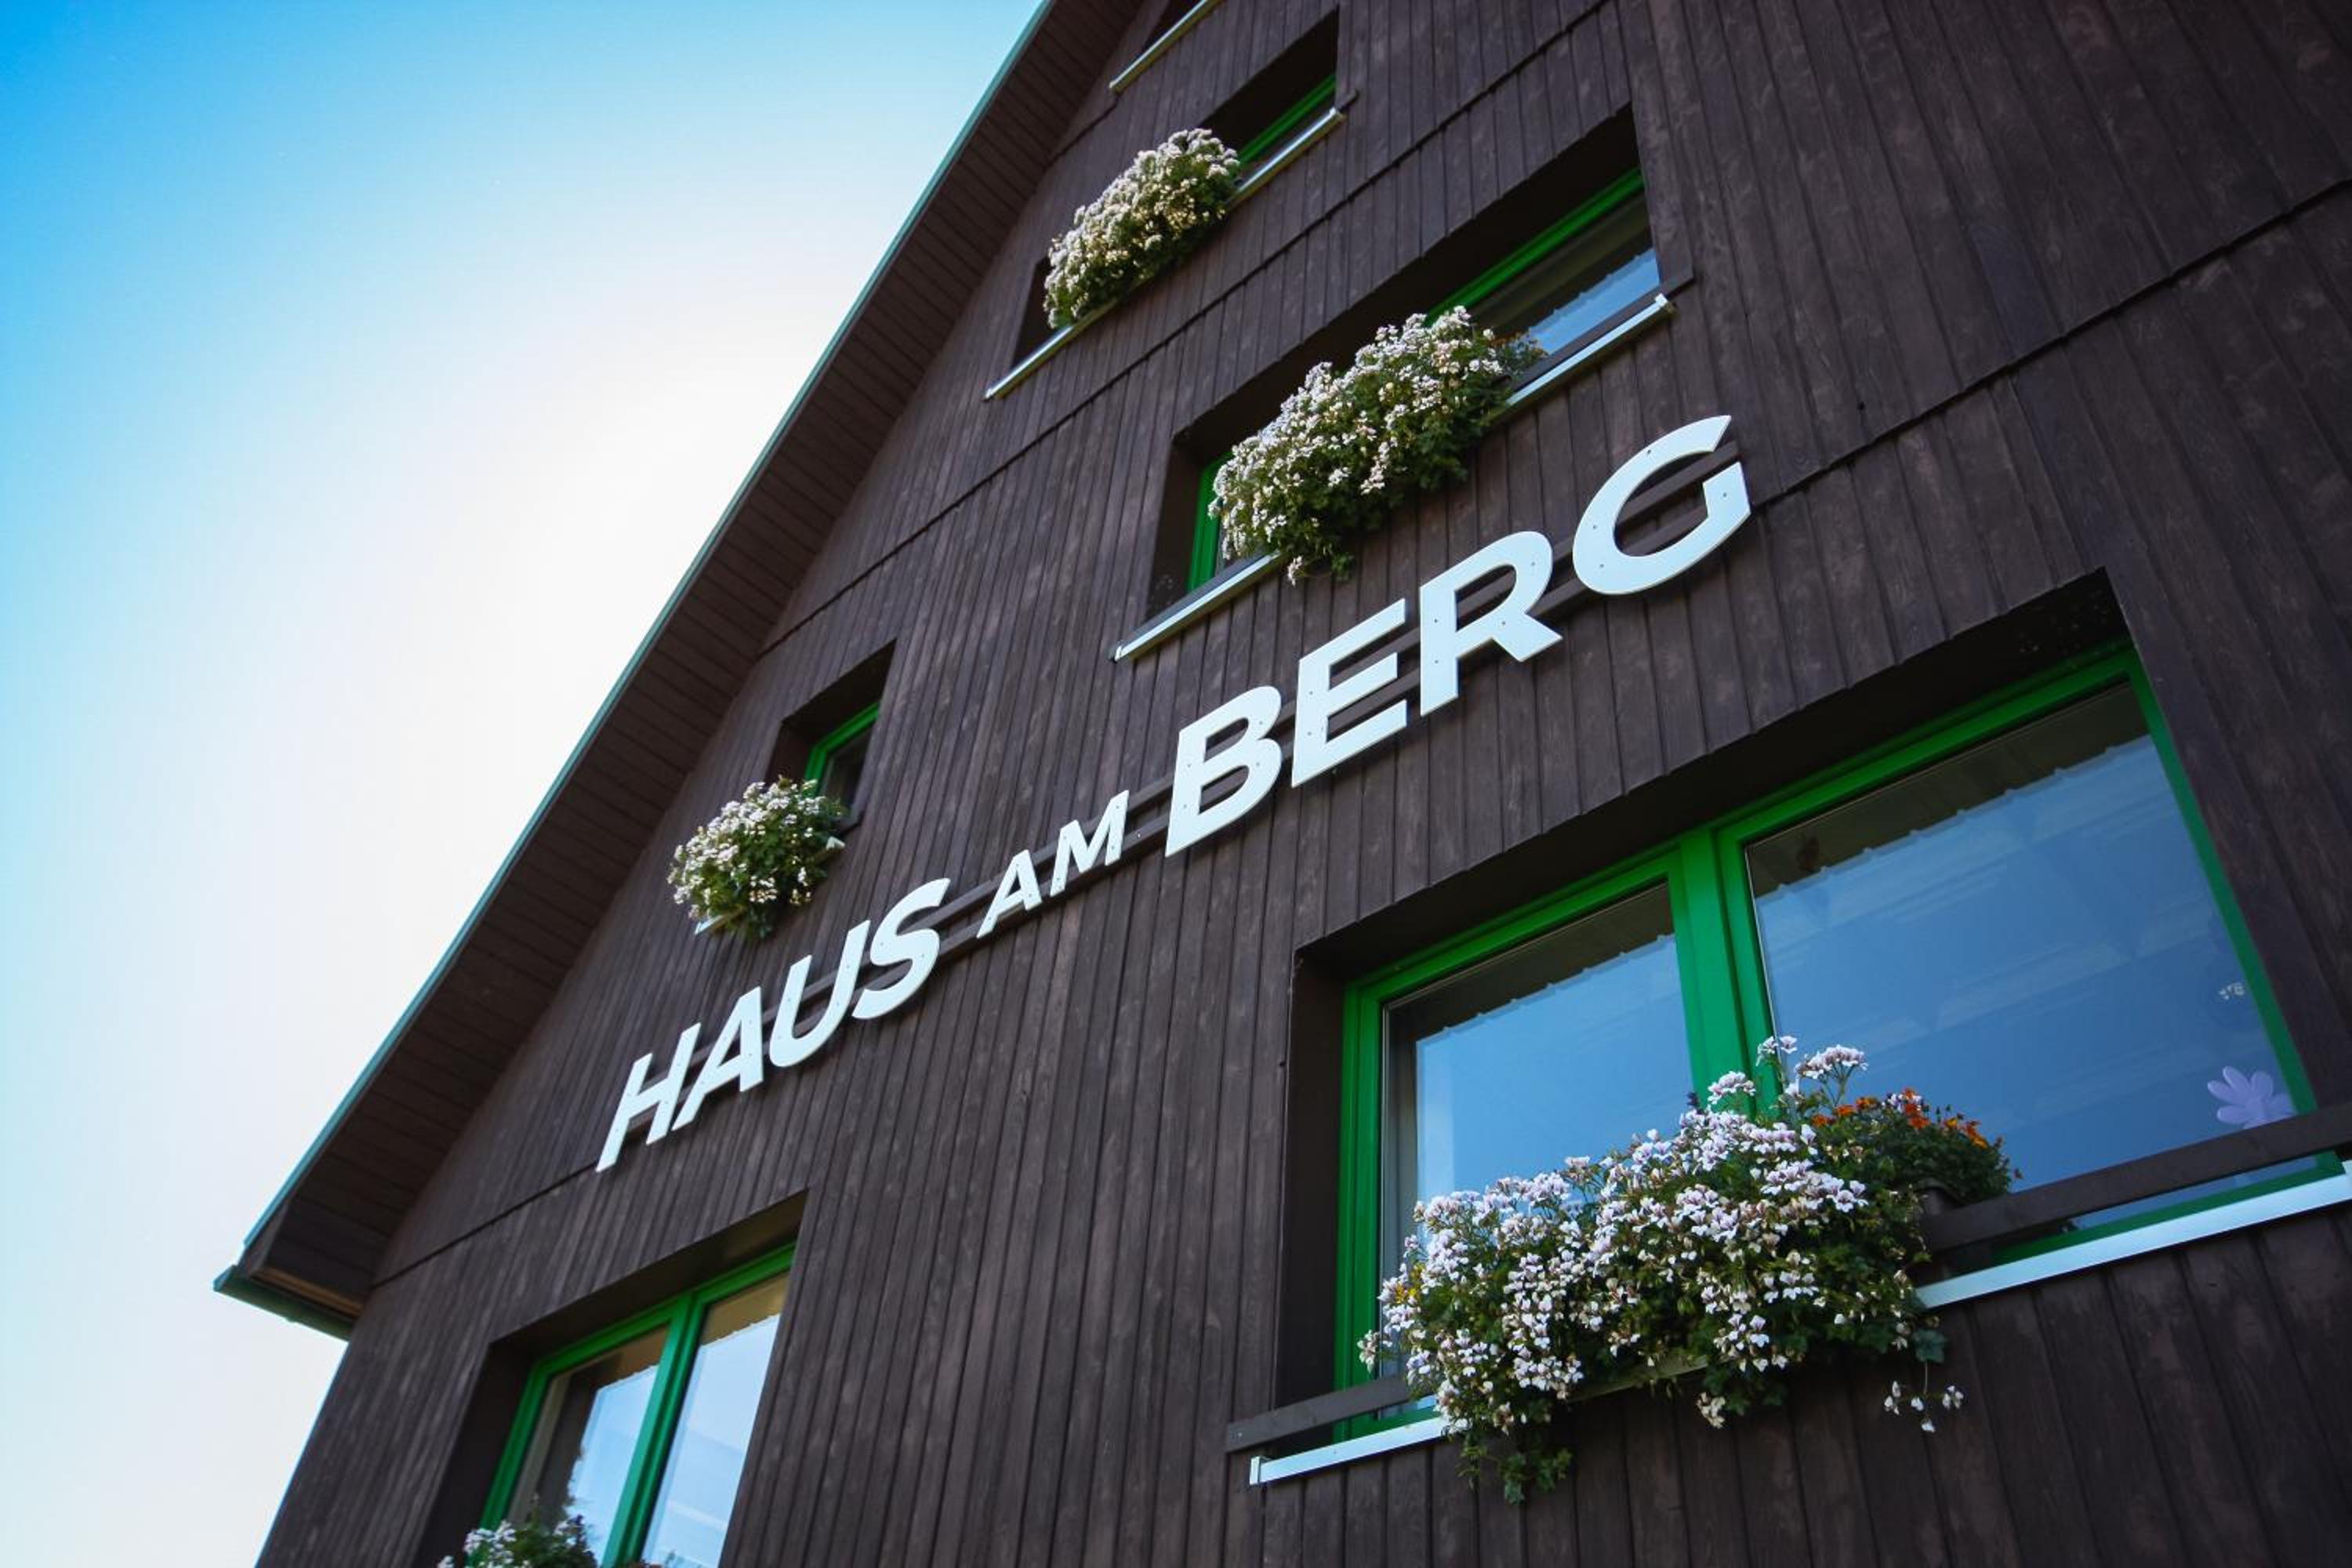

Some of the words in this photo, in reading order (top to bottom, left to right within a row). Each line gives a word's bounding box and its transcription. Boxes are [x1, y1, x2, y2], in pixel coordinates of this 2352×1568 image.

[596, 877, 951, 1173] HAUS
[976, 789, 1130, 938] AM
[1164, 414, 1751, 858] BERG
